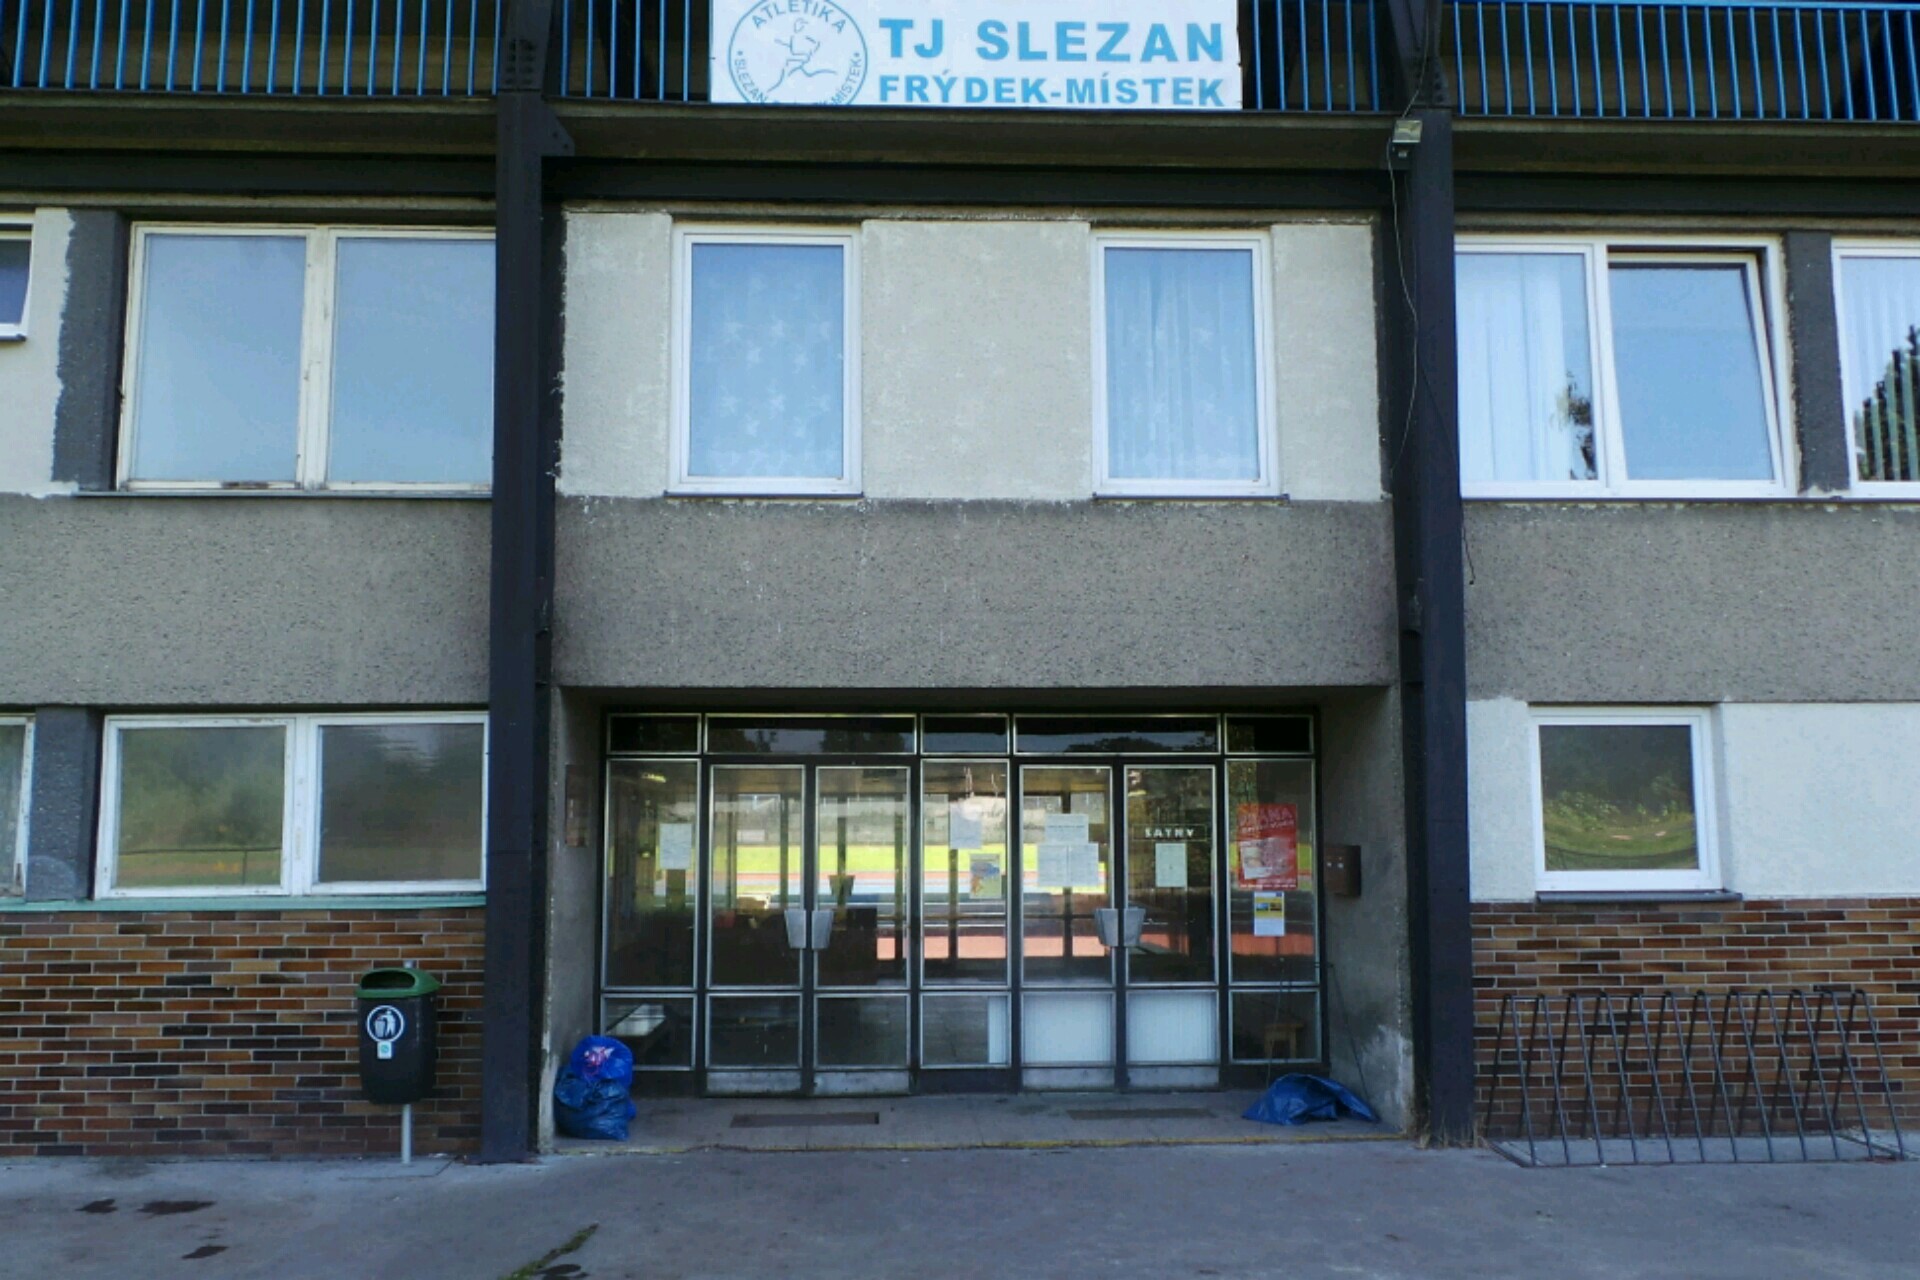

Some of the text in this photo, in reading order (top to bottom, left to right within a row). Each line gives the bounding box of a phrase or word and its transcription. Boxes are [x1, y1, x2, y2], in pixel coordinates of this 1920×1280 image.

[751, 0, 846, 34] ATLETIKA
[879, 18, 1223, 62] TJ SLEZAN
[878, 69, 1225, 107] FRÝDEK-MÍSTEK
